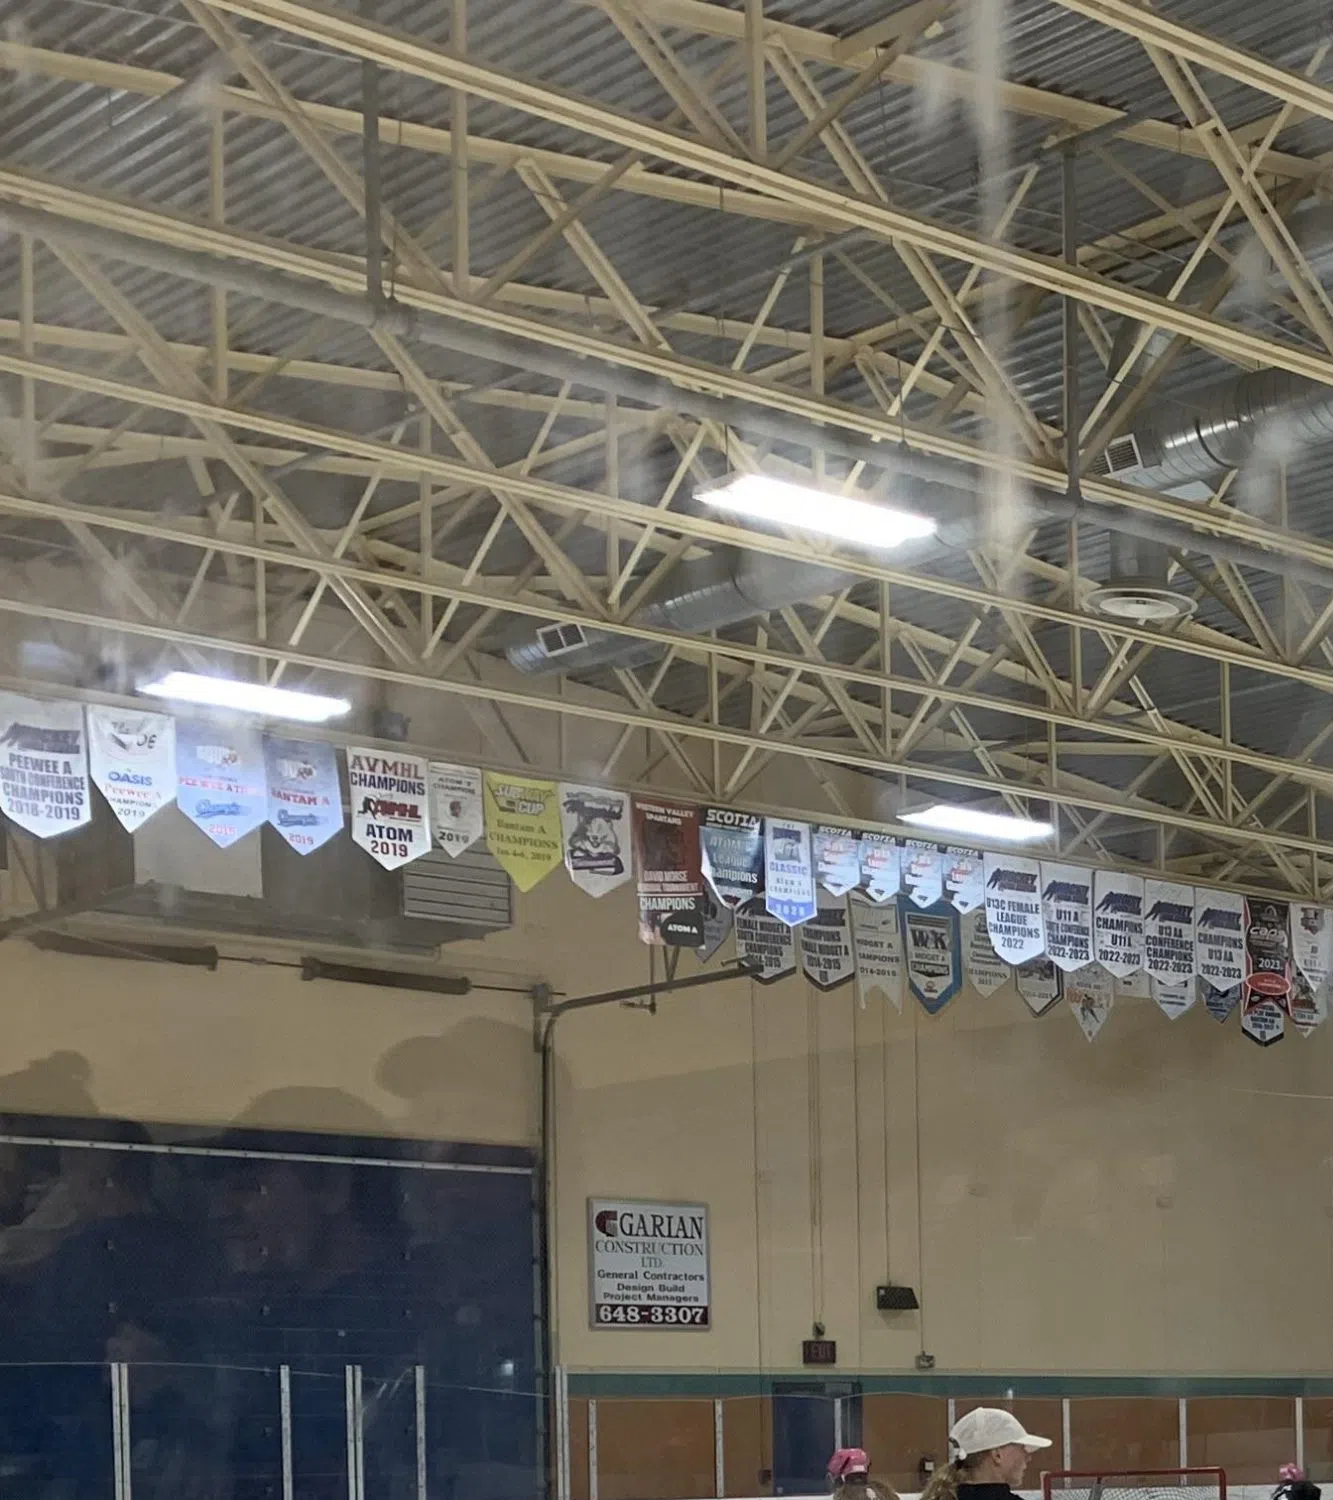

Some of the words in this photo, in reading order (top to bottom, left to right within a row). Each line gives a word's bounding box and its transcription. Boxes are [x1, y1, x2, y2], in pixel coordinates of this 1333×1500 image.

[9, 753, 59, 774] PEEWEE
[62, 761, 72, 775] A
[350, 755, 424, 779] AVMHL
[29, 771, 85, 790] CONFERENCE
[108, 771, 152, 786] OASIS
[350, 772, 425, 796] CHAMPIONS
[3, 782, 83, 805] CHAMPIONS
[8, 798, 80, 820] 2018-2019
[518, 801, 545, 816] CUP
[706, 809, 758, 827] SCOTIA
[366, 824, 413, 842] ATOM
[819, 826, 852, 837] SCOTIA
[862, 832, 895, 844] SCOTIA
[489, 832, 559, 849] CHAMPIONS
[906, 839, 938, 850] SCOTIA
[371, 841, 408, 857] 2019
[640, 897, 696, 910] CHAMPIONS
[986, 897, 1006, 910] U13C
[1007, 901, 1040, 914] FEMALE
[996, 911, 1027, 925] LEAGUE
[1056, 909, 1071, 921] U11
[1073, 911, 1079, 922] A
[667, 924, 690, 932] ATOM
[691, 925, 698, 933] A
[988, 921, 1040, 939] CHAMPIONS
[1001, 937, 1024, 949] 2022
[1047, 932, 1089, 949] CHAMPIONS
[1145, 935, 1193, 951] CONFERENCE
[1197, 932, 1243, 950] CHAMPIONS
[1047, 945, 1090, 960] 2022-2023
[1098, 949, 1140, 965] 2022-2023
[1146, 947, 1193, 962] CHAMPIONS
[1148, 959, 1193, 974] 2022-2023
[1201, 963, 1241, 979] 2022-2023
[1259, 959, 1280, 970] 2023
[620, 1212, 703, 1239] GARIAN
[595, 1240, 703, 1256] CONSTRUCTION
[597, 1269, 638, 1280] General
[643, 1271, 704, 1281] Contractors
[617, 1283, 654, 1292] Design
[659, 1284, 685, 1292] Build
[604, 1292, 642, 1302] Project
[646, 1294, 699, 1303] Managers
[600, 1305, 704, 1323] 648-3307
